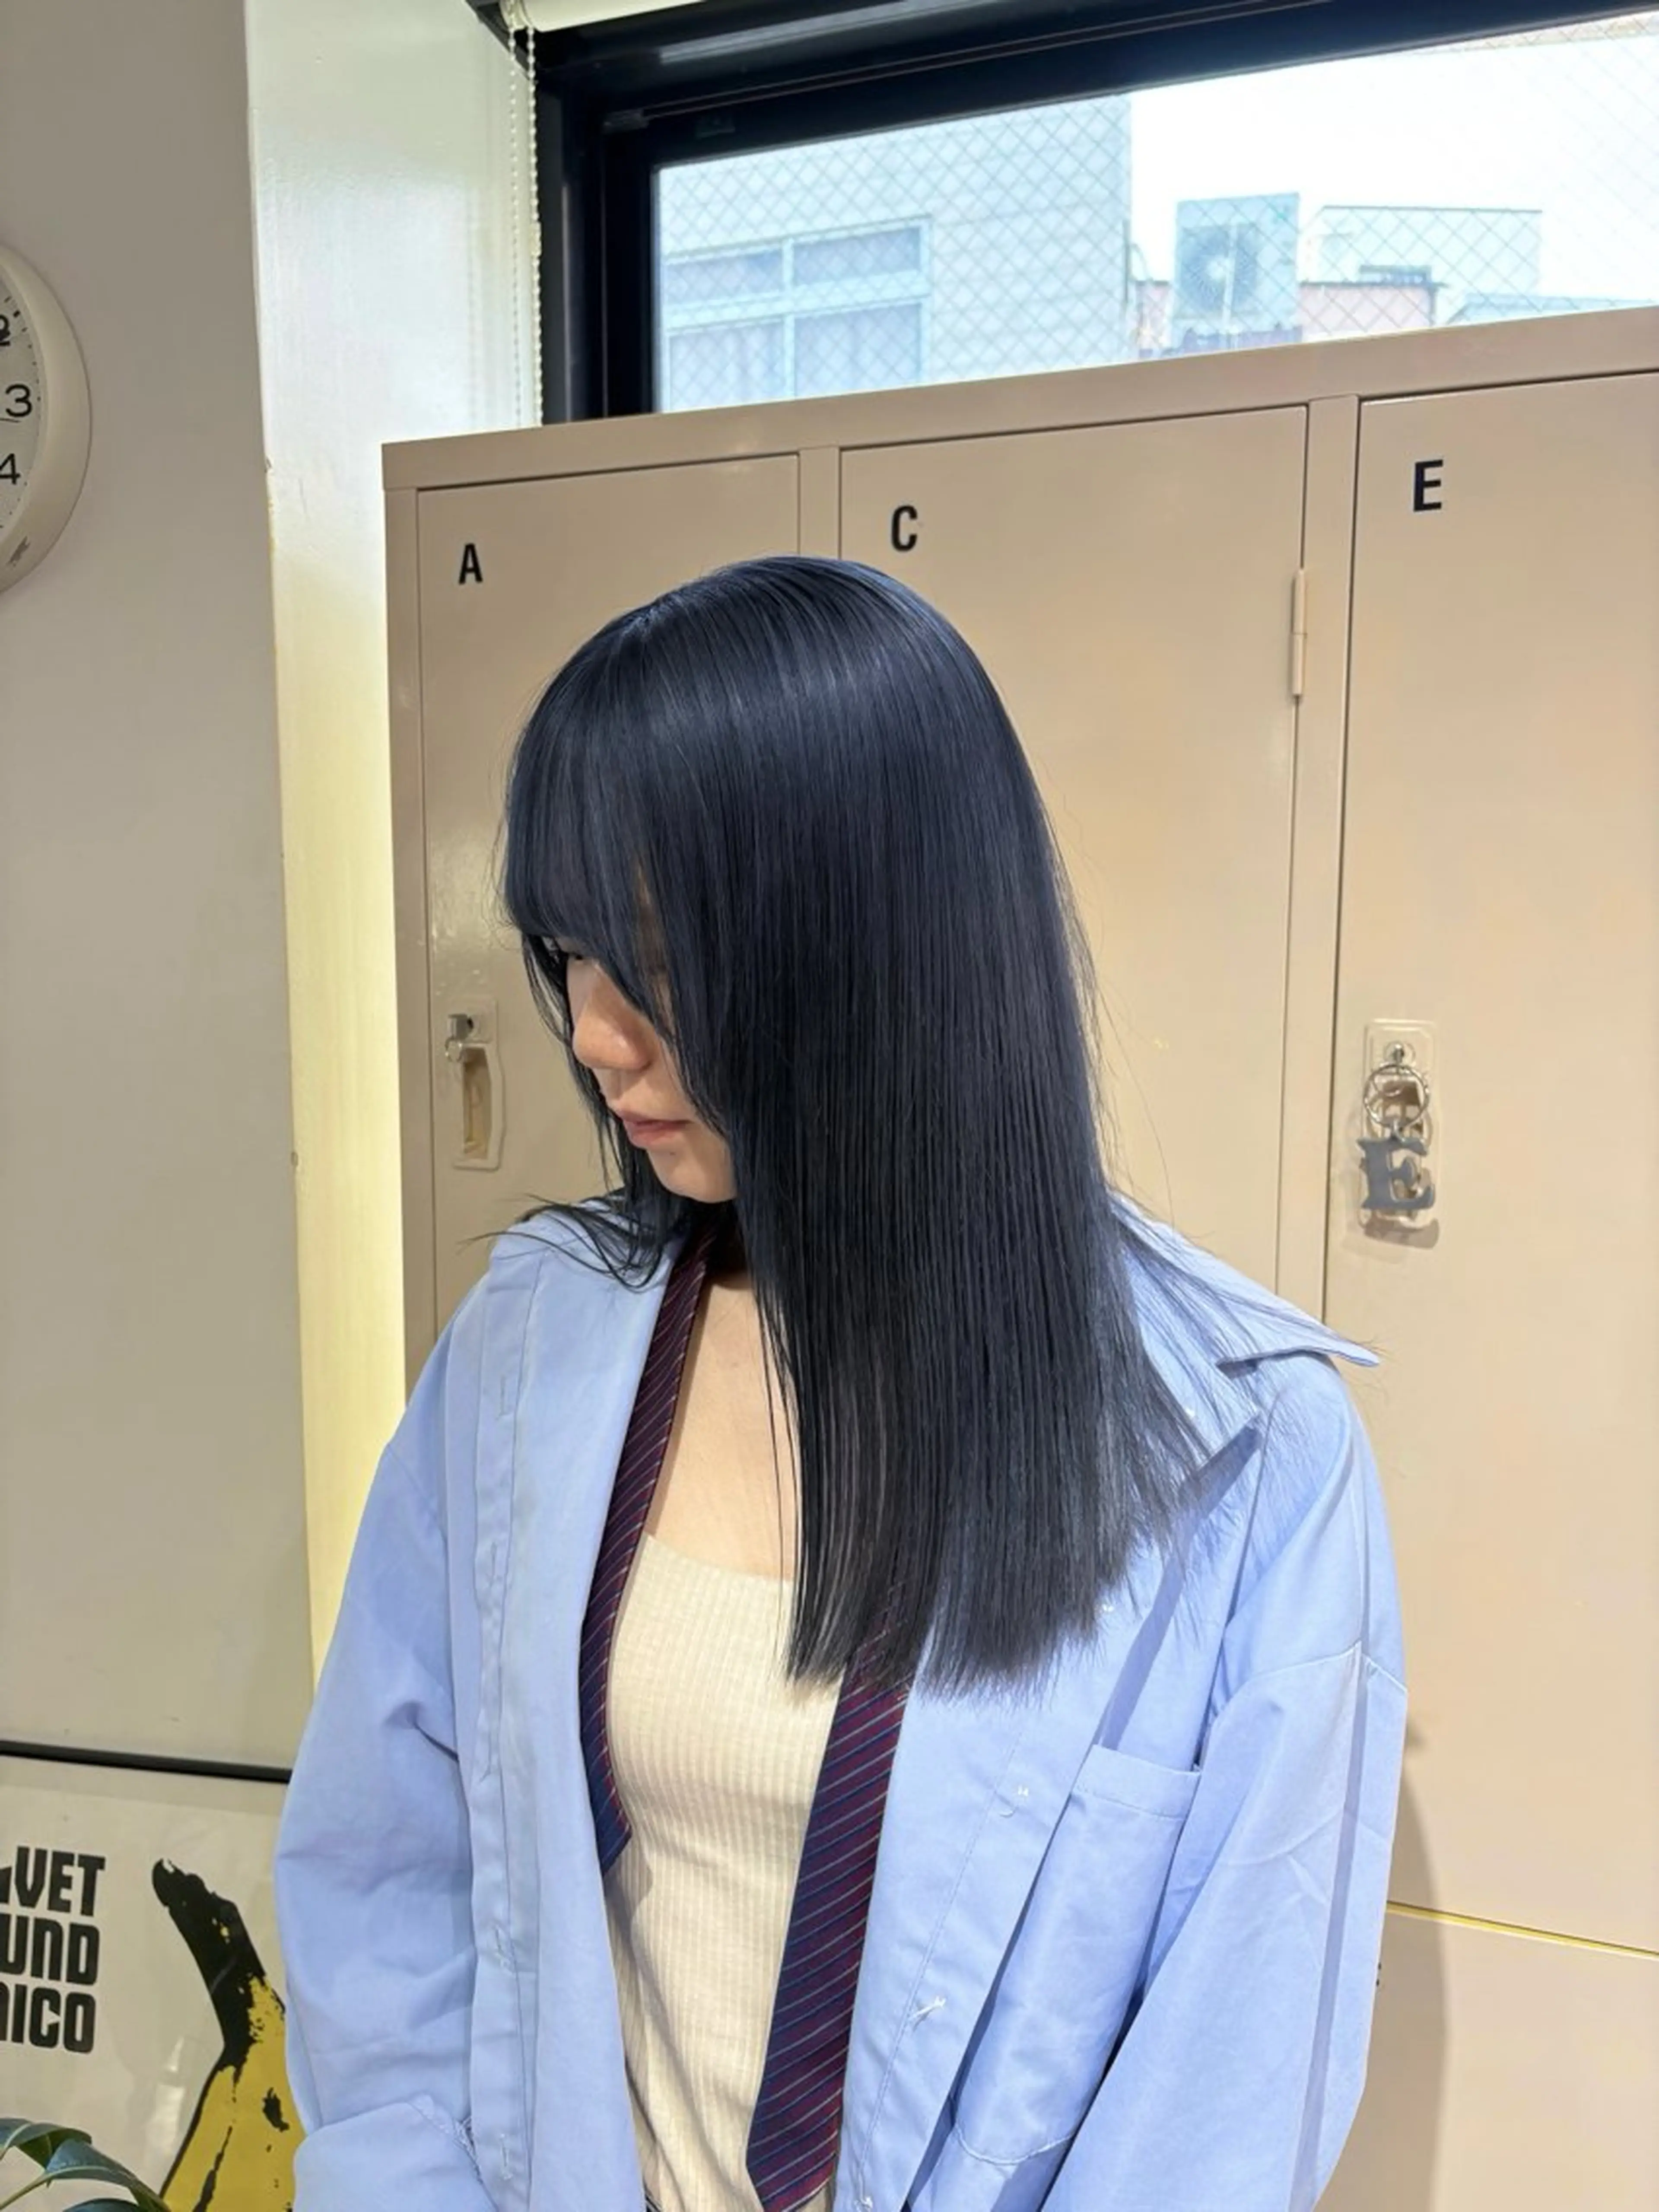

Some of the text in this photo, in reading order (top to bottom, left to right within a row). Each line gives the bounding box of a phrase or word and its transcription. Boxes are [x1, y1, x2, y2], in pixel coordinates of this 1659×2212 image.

[5, 384, 33, 418] 3
[0, 453, 21, 486] 4
[1413, 460, 1443, 512] E
[891, 505, 918, 552] C
[458, 542, 483, 585] A
